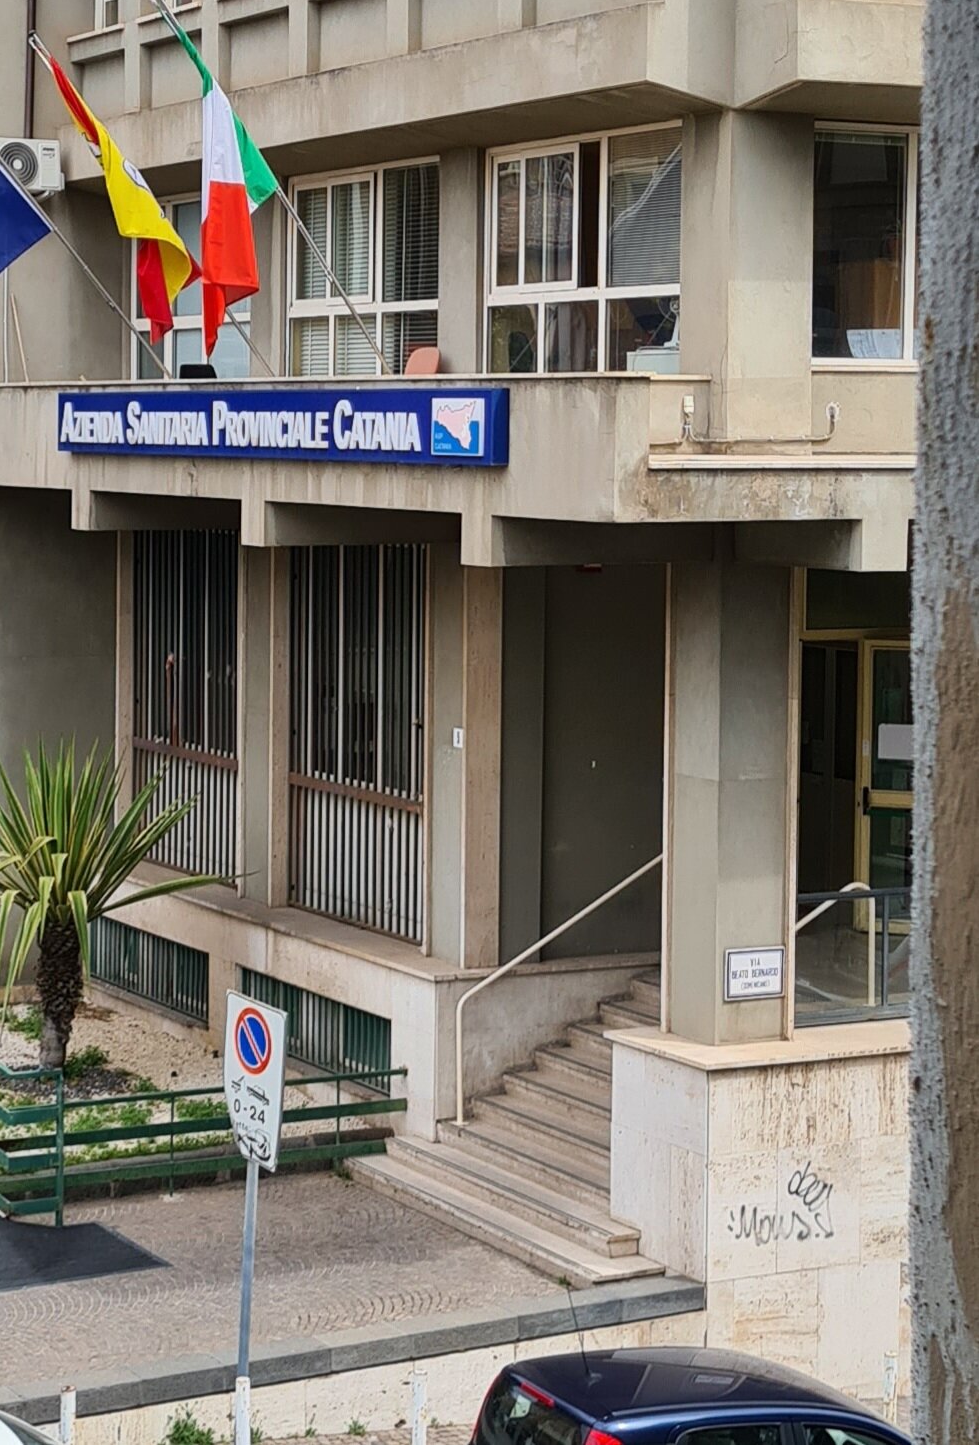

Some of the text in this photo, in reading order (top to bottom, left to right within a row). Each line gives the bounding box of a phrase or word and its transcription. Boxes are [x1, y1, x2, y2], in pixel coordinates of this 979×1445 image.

[60, 399, 422, 452] AZIENDA SANITARIA PROVINCIALE CATANIA
[750, 957, 761, 968] VIA
[731, 969, 748, 980] BEATO
